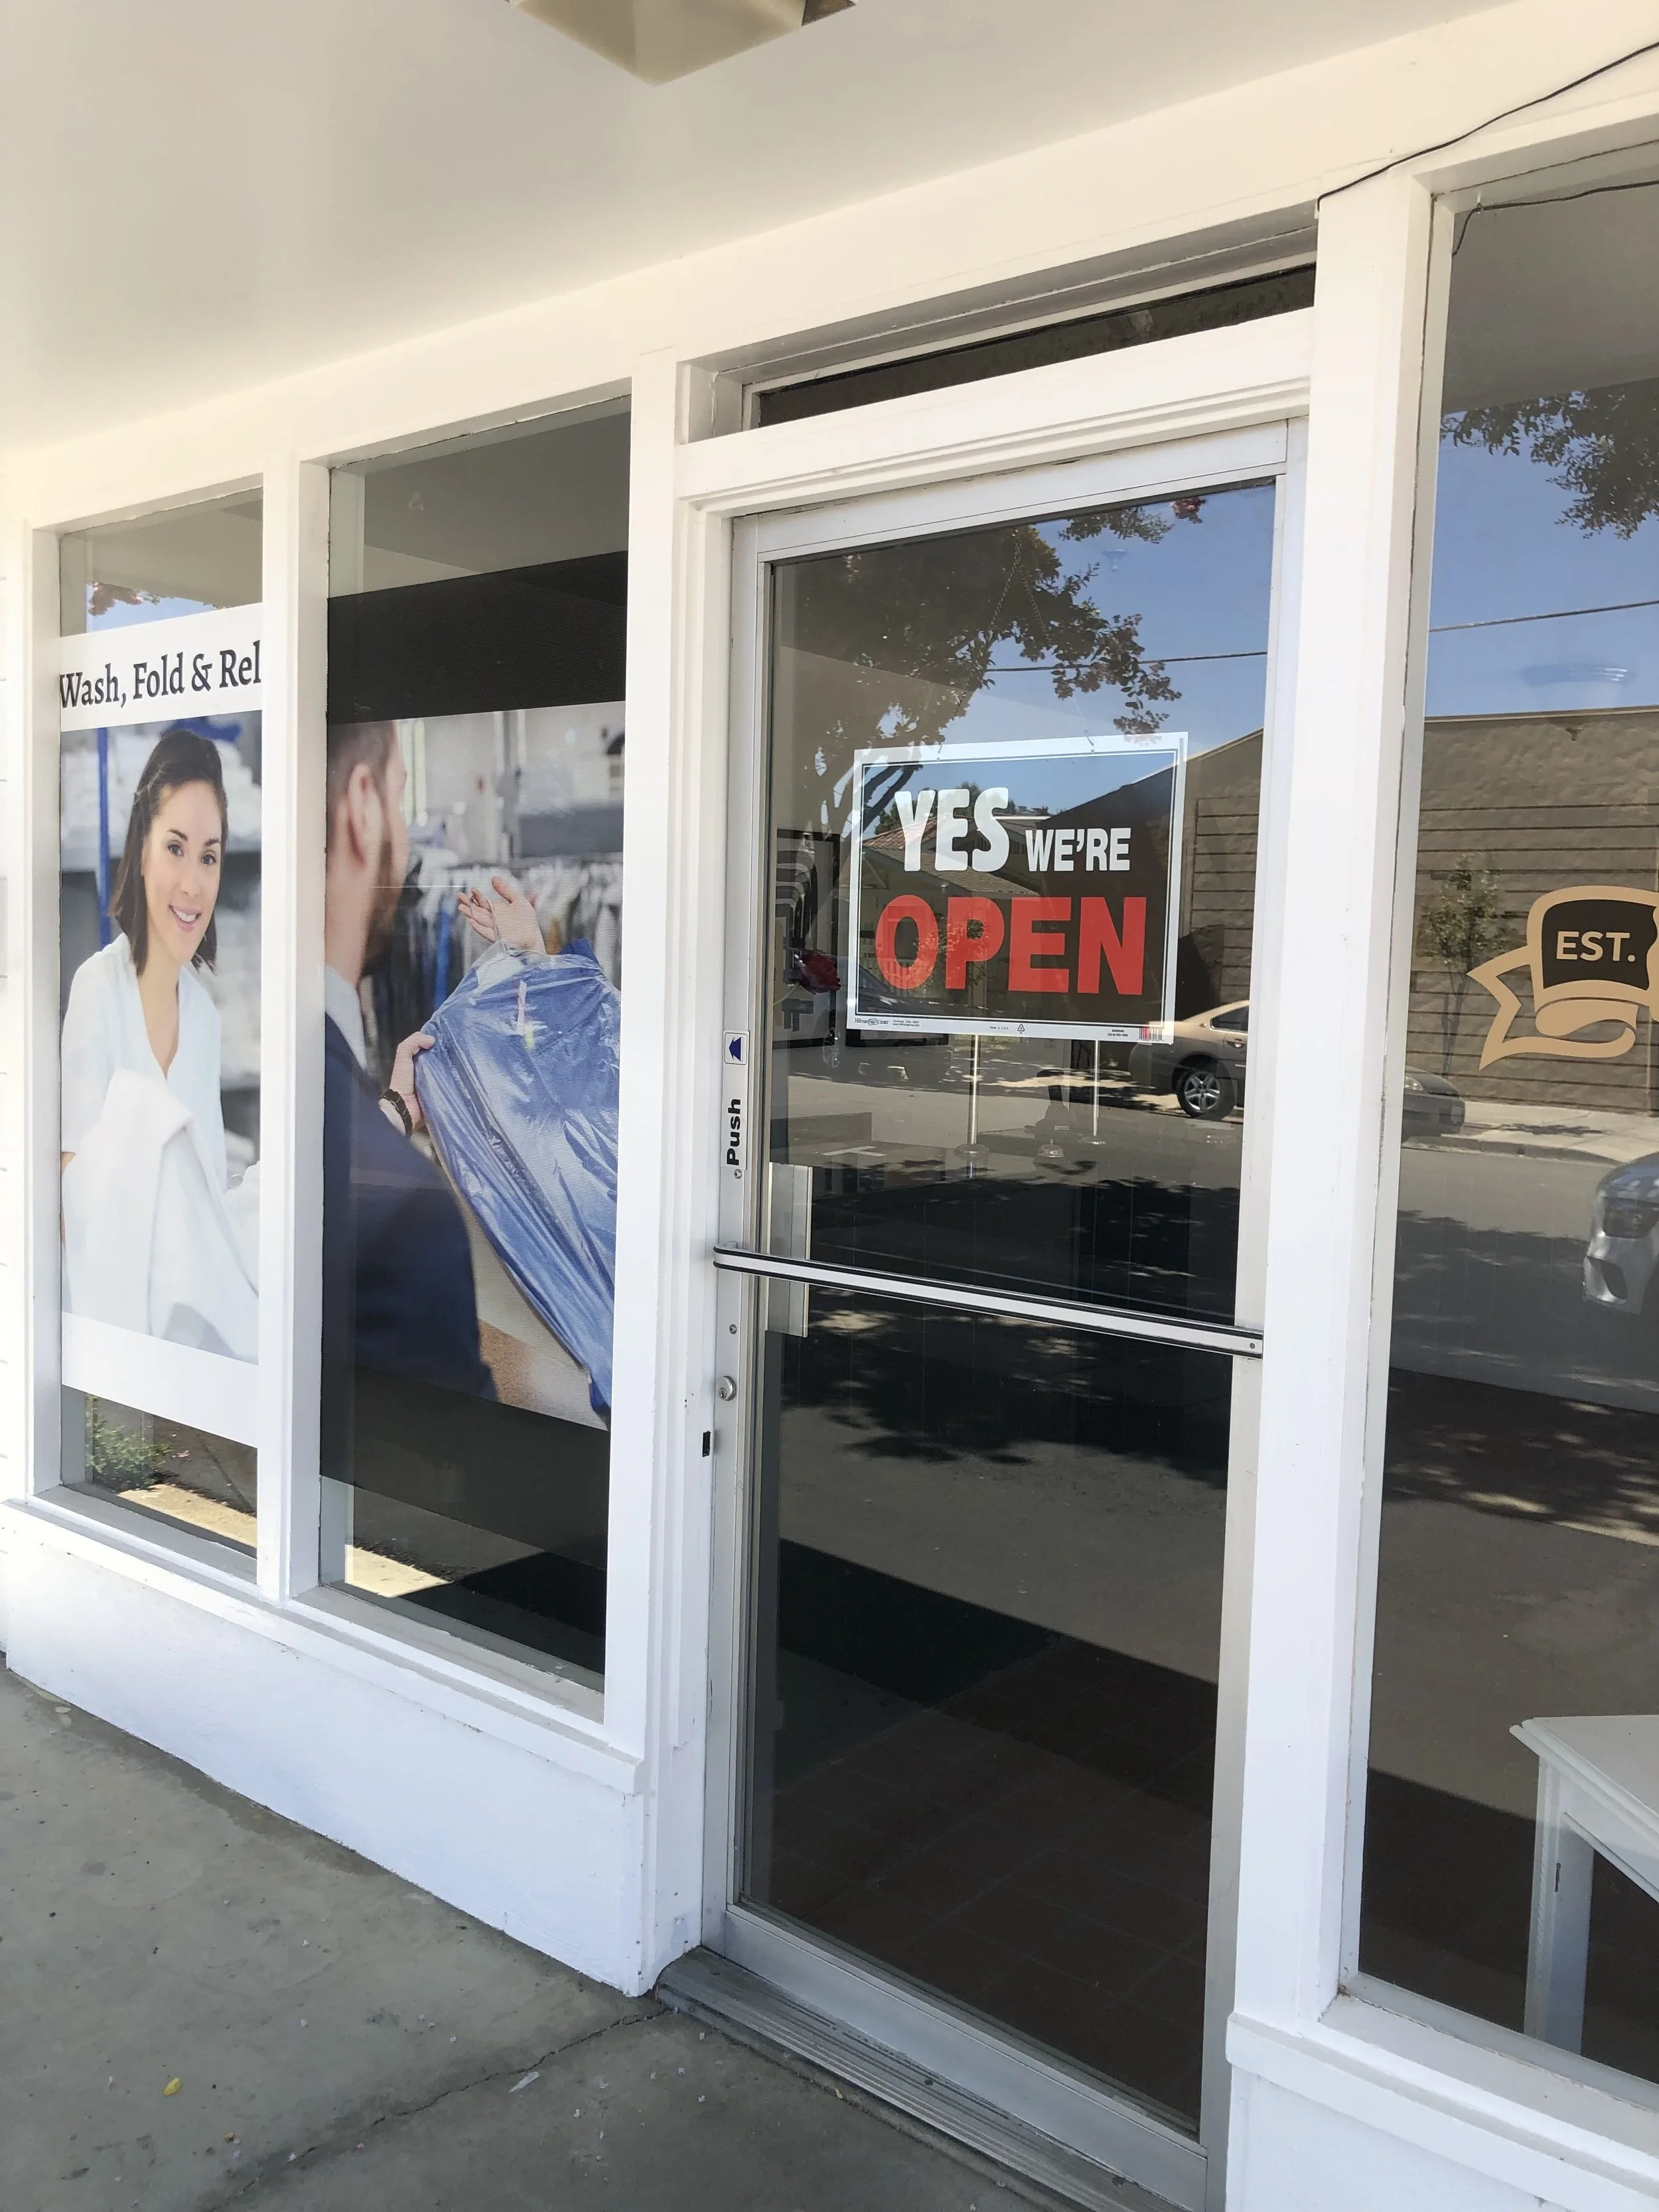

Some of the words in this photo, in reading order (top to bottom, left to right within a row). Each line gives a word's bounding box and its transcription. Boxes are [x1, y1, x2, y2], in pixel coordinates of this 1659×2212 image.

[60, 662, 127, 709] Wash,
[133, 651, 185, 700] Fold
[191, 653, 213, 692] &
[219, 640, 261, 689] Rel
[894, 787, 1010, 872] YES
[1025, 828, 1132, 872] WE'RE
[875, 895, 1147, 995] OPEN
[1556, 930, 1636, 962] EST.
[727, 1098, 741, 1165] Push
